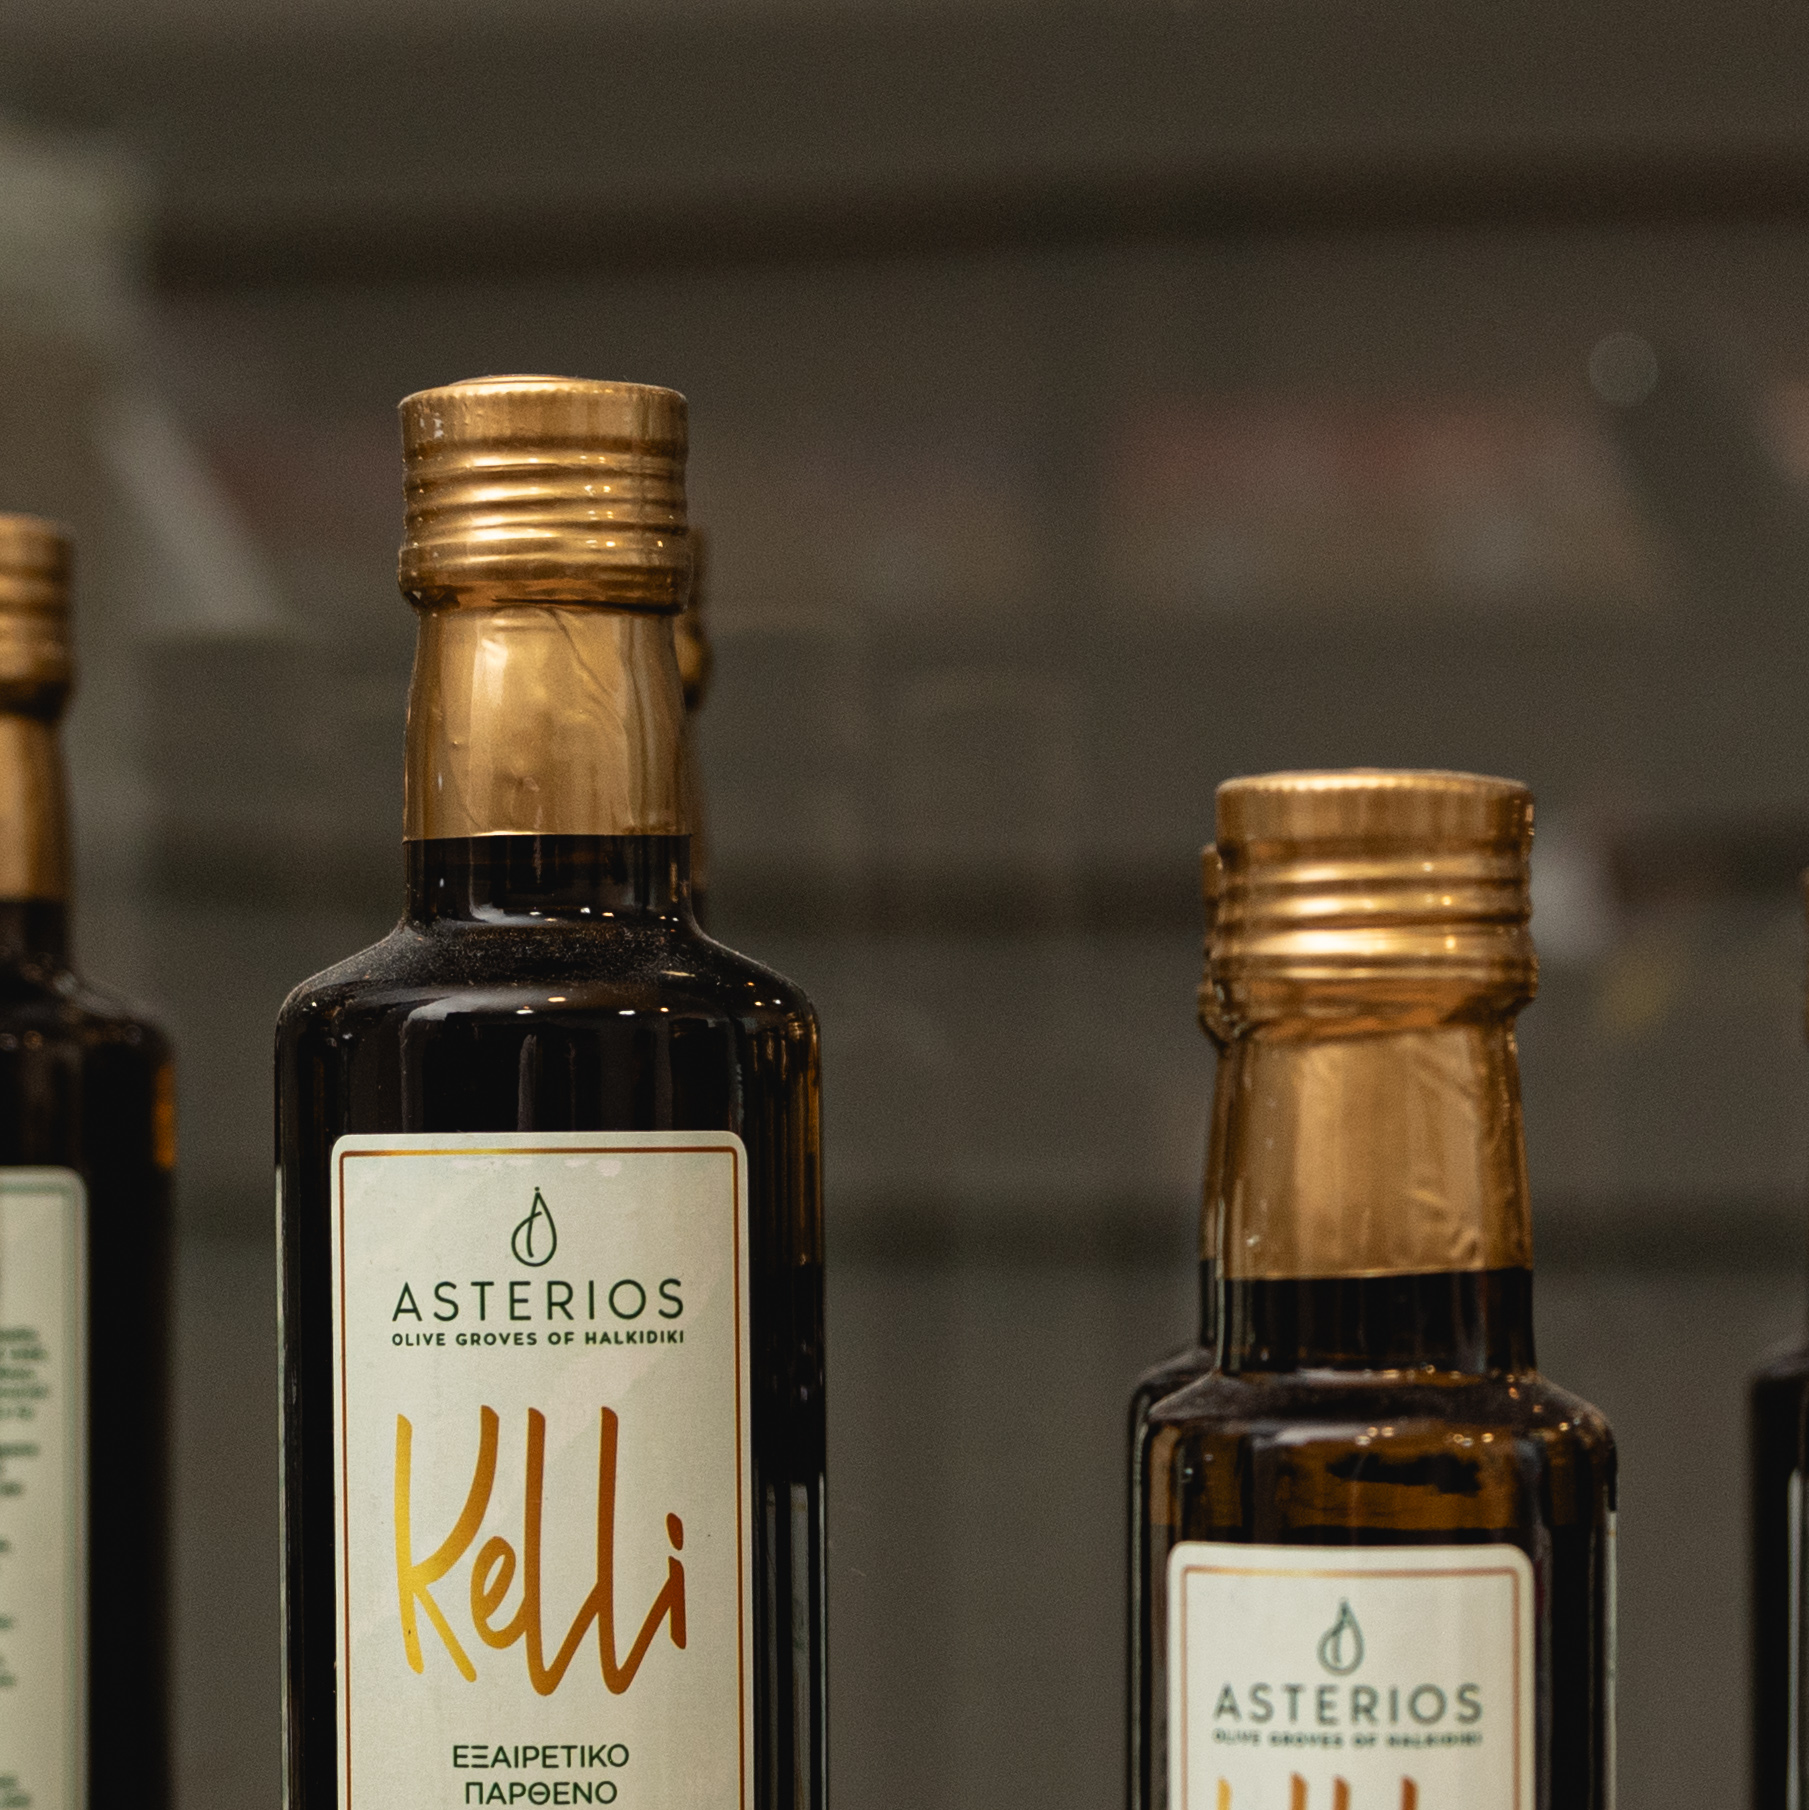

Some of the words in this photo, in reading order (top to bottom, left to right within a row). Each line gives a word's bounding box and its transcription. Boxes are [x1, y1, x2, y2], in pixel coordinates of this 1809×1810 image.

[392, 1278, 684, 1322] ASTERIOS
[392, 1333, 447, 1347] OLIVE
[456, 1332, 538, 1346] GROVES
[548, 1331, 575, 1345] OF
[585, 1329, 684, 1345] HALKIDIKI
[394, 1405, 686, 1696] Kelli
[1214, 1682, 1483, 1726] ASTERIOS
[452, 1744, 629, 1768] ΕΞΑΙΡΕΤΙΚΟ
[465, 1781, 617, 1805] ΠΑΡΘΕΝΟ
